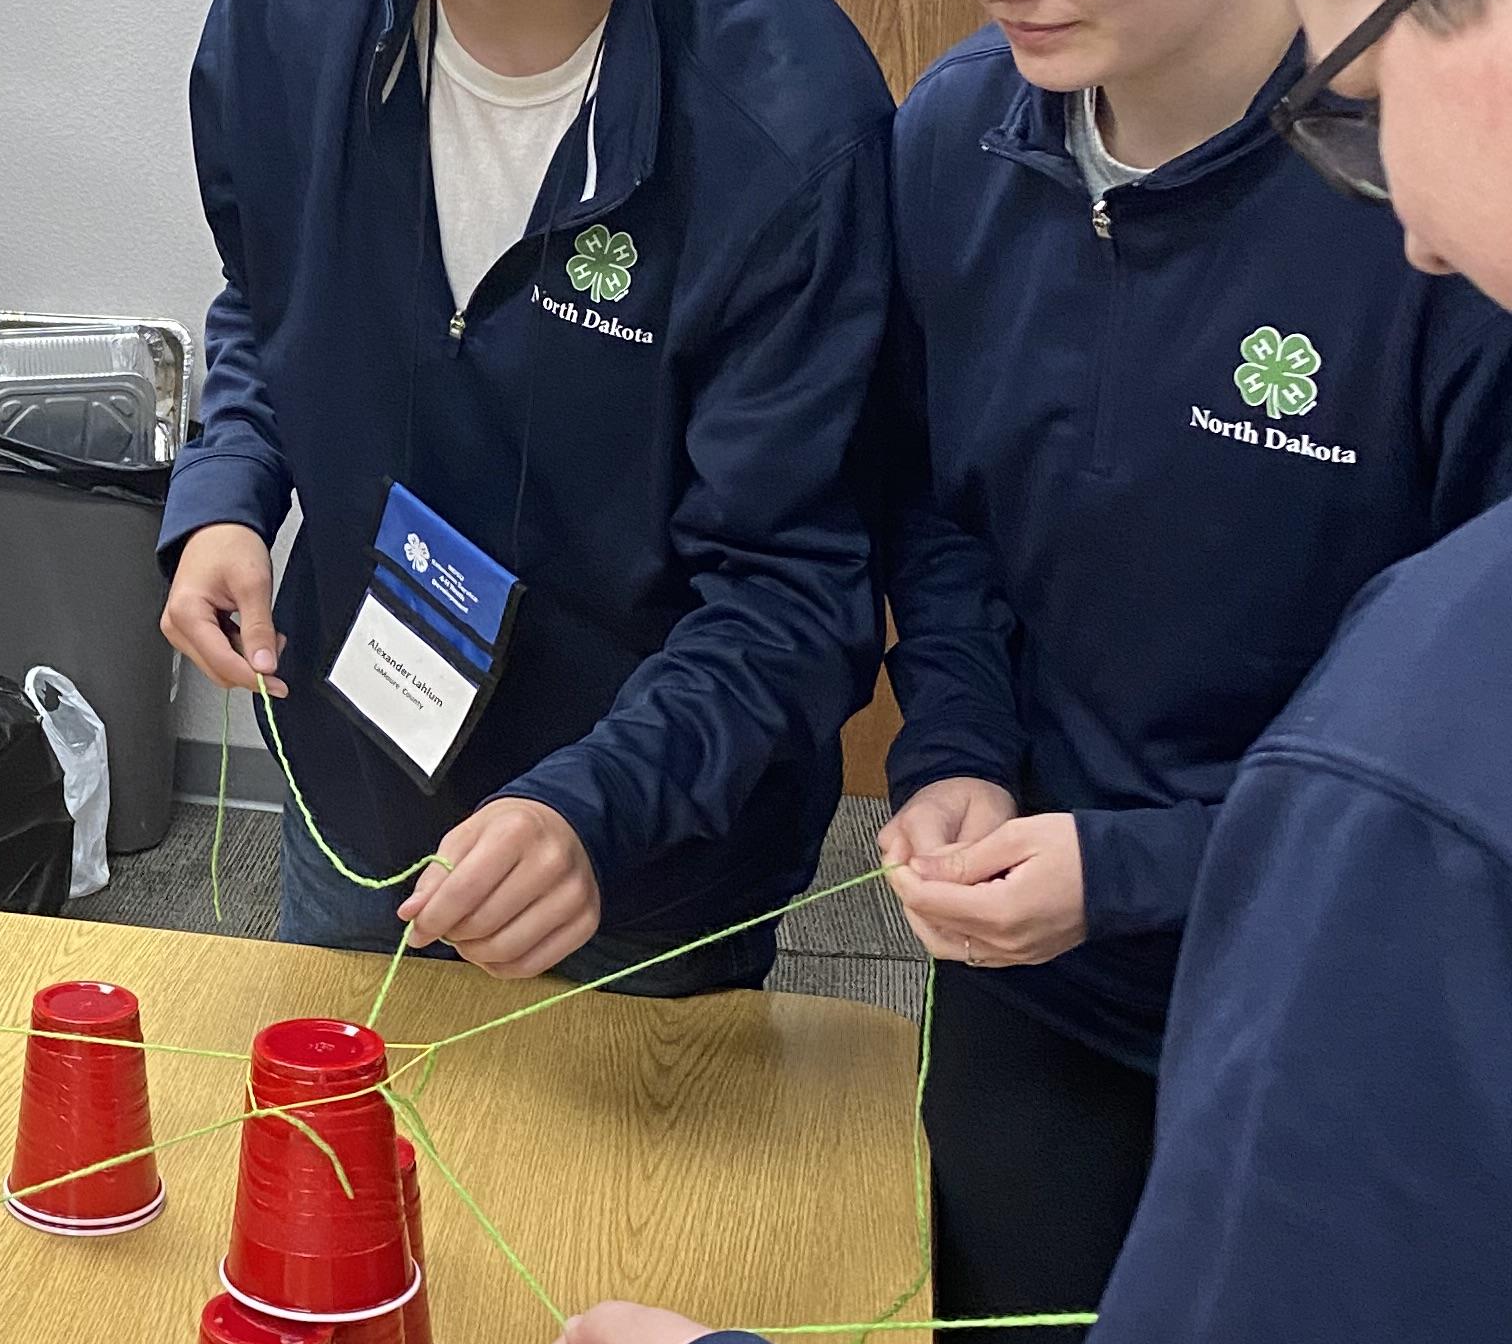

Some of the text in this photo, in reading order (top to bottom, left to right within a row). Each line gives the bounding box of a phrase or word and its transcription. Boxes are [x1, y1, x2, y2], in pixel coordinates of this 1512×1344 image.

[582, 308, 653, 344] Dakota
[1190, 405, 1357, 464] North Dakota
[368, 638, 443, 707] Alexander Lahlum
[402, 688, 424, 710] County
